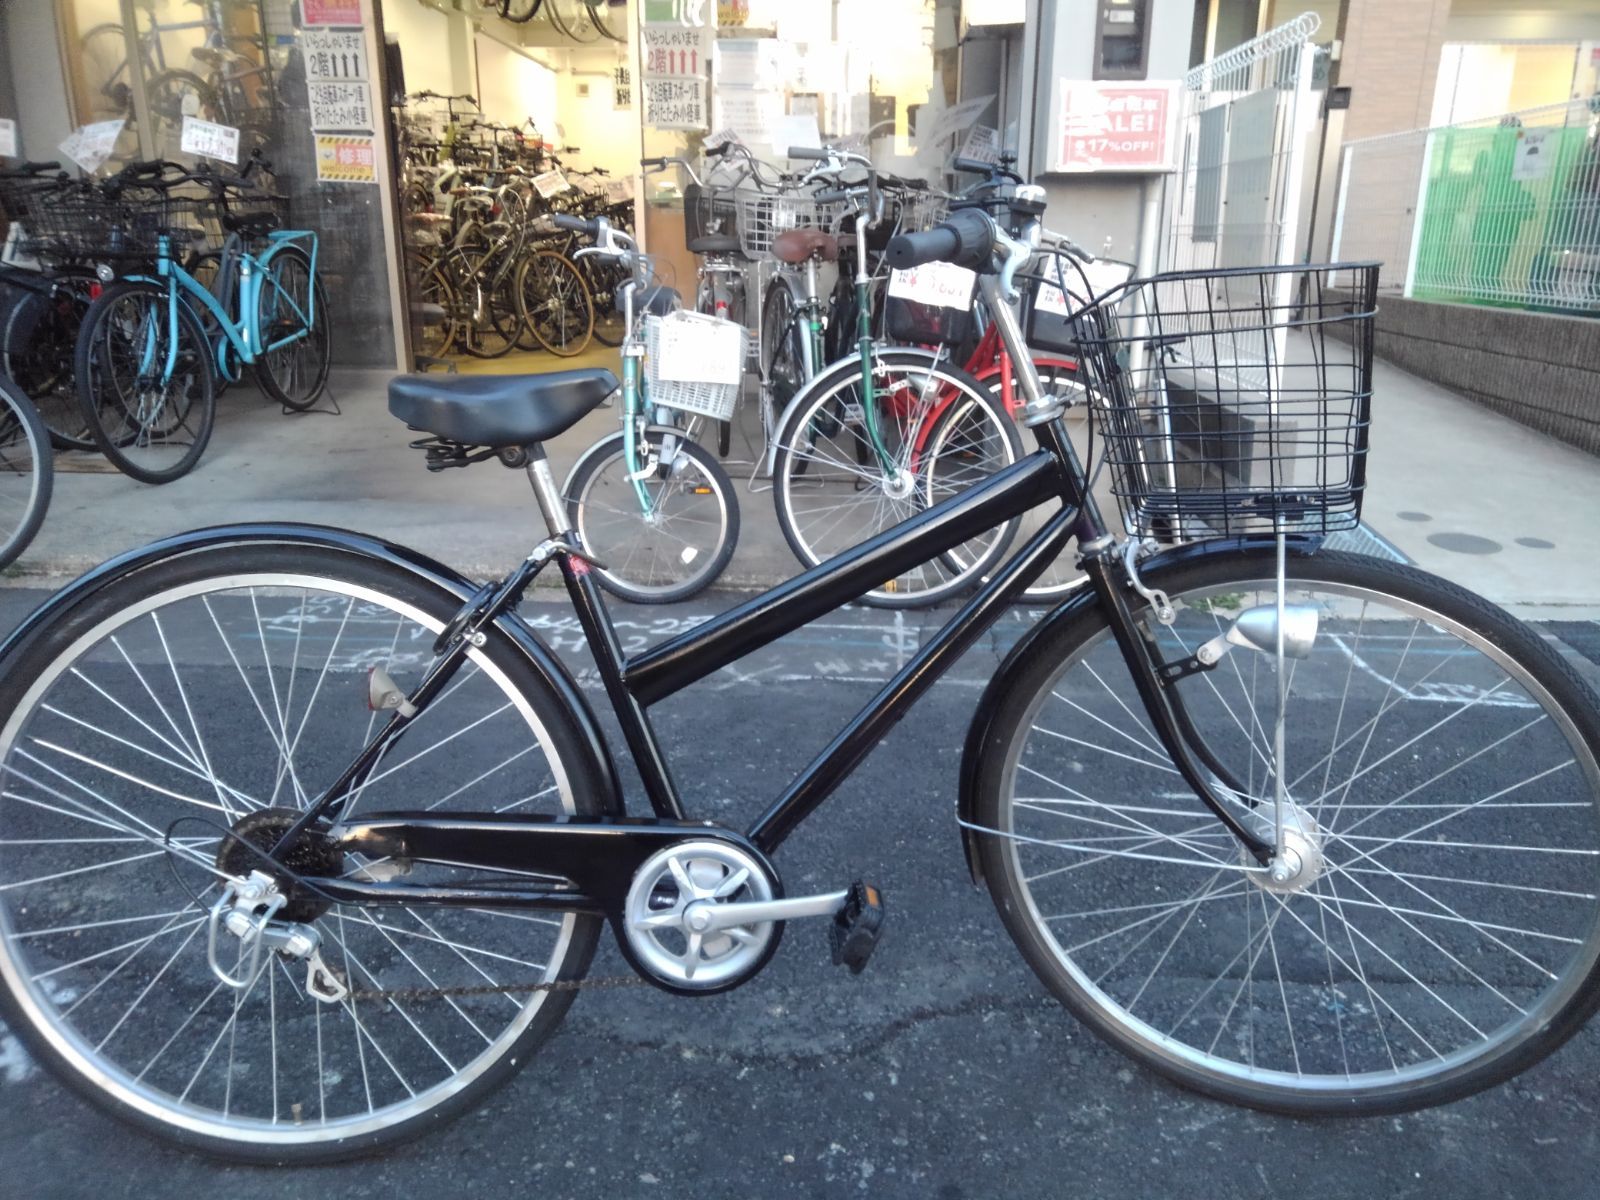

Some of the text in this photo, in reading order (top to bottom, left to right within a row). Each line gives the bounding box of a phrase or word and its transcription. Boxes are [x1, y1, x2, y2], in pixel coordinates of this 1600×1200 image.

[304, 34, 360, 49] いらっしゃいませ
[644, 30, 700, 46] いらっしゃいませ
[309, 52, 329, 77] 2階
[648, 48, 667, 74] 2階
[1090, 114, 1154, 132] ALE!
